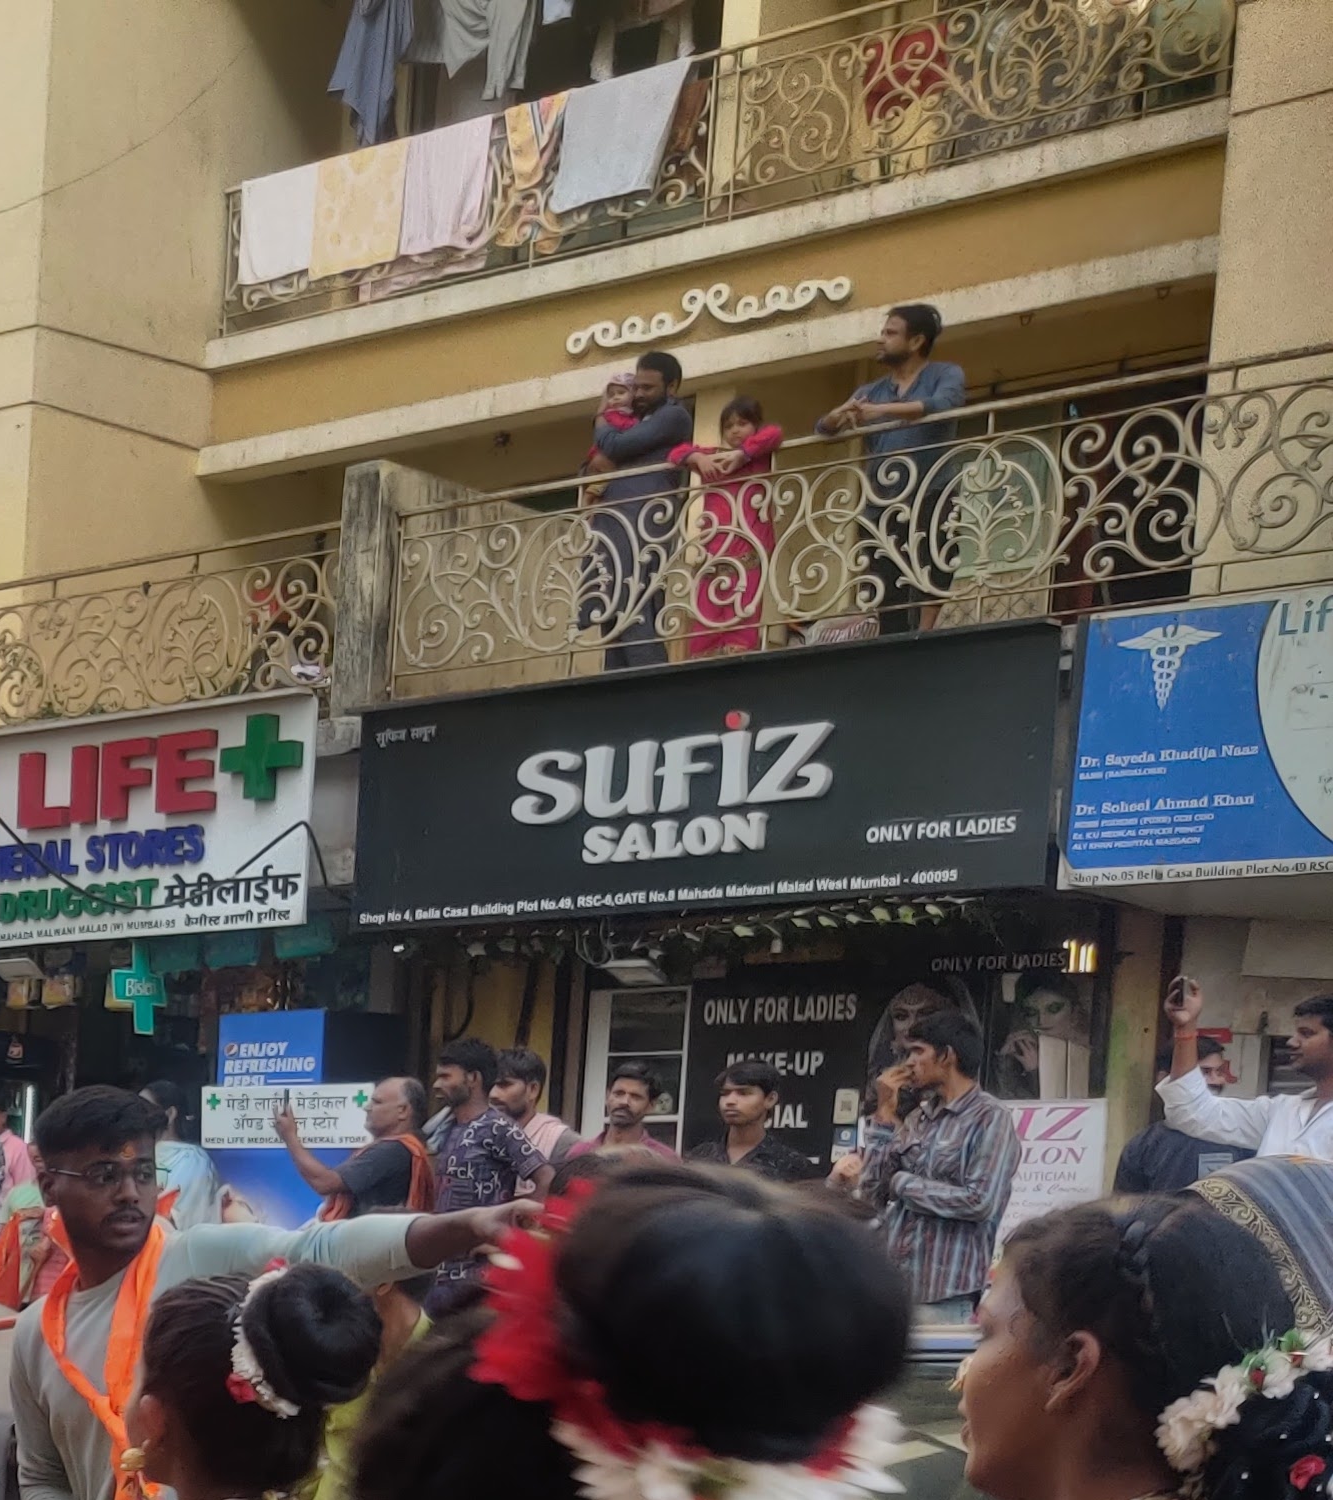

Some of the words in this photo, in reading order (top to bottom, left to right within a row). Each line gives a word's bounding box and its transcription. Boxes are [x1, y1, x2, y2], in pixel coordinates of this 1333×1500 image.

[1079, 754, 1102, 769] Dr.
[17, 728, 219, 830] LIFE
[1153, 795, 1209, 811] Ahmad
[1212, 792, 1256, 807] Khan
[581, 811, 769, 865] SALON
[866, 825, 913, 844] ONLY
[916, 821, 952, 841] FOR
[955, 816, 1018, 838] LADIES
[85, 824, 205, 873] STORES
[1196, 865, 1244, 878] Building
[359, 911, 385, 924] Shop
[387, 910, 402, 922] No
[443, 906, 469, 918] Casa
[471, 901, 515, 917] Building
[517, 900, 538, 913] Plot
[677, 887, 724, 901] Mahada
[725, 883, 775, 898] Malwani
[777, 880, 814, 894] Malad
[817, 877, 848, 892] West
[850, 873, 901, 890] Mumbai
[911, 870, 958, 885] 400095
[78, 925, 108, 935] MALAD
[932, 958, 973, 972] ONLY
[977, 955, 1007, 971] FOR
[1012, 951, 1067, 970] LADIES
[704, 1000, 748, 1025] ONLY
[753, 998, 788, 1023] FOR
[793, 994, 857, 1022] LADIES
[239, 1042, 288, 1058] ENJOY
[223, 1056, 316, 1075] REFRESHING
[763, 1103, 808, 1129] IAL
[1022, 1146, 1087, 1164] LON
[1017, 1171, 1077, 1182] AUTICIAN
